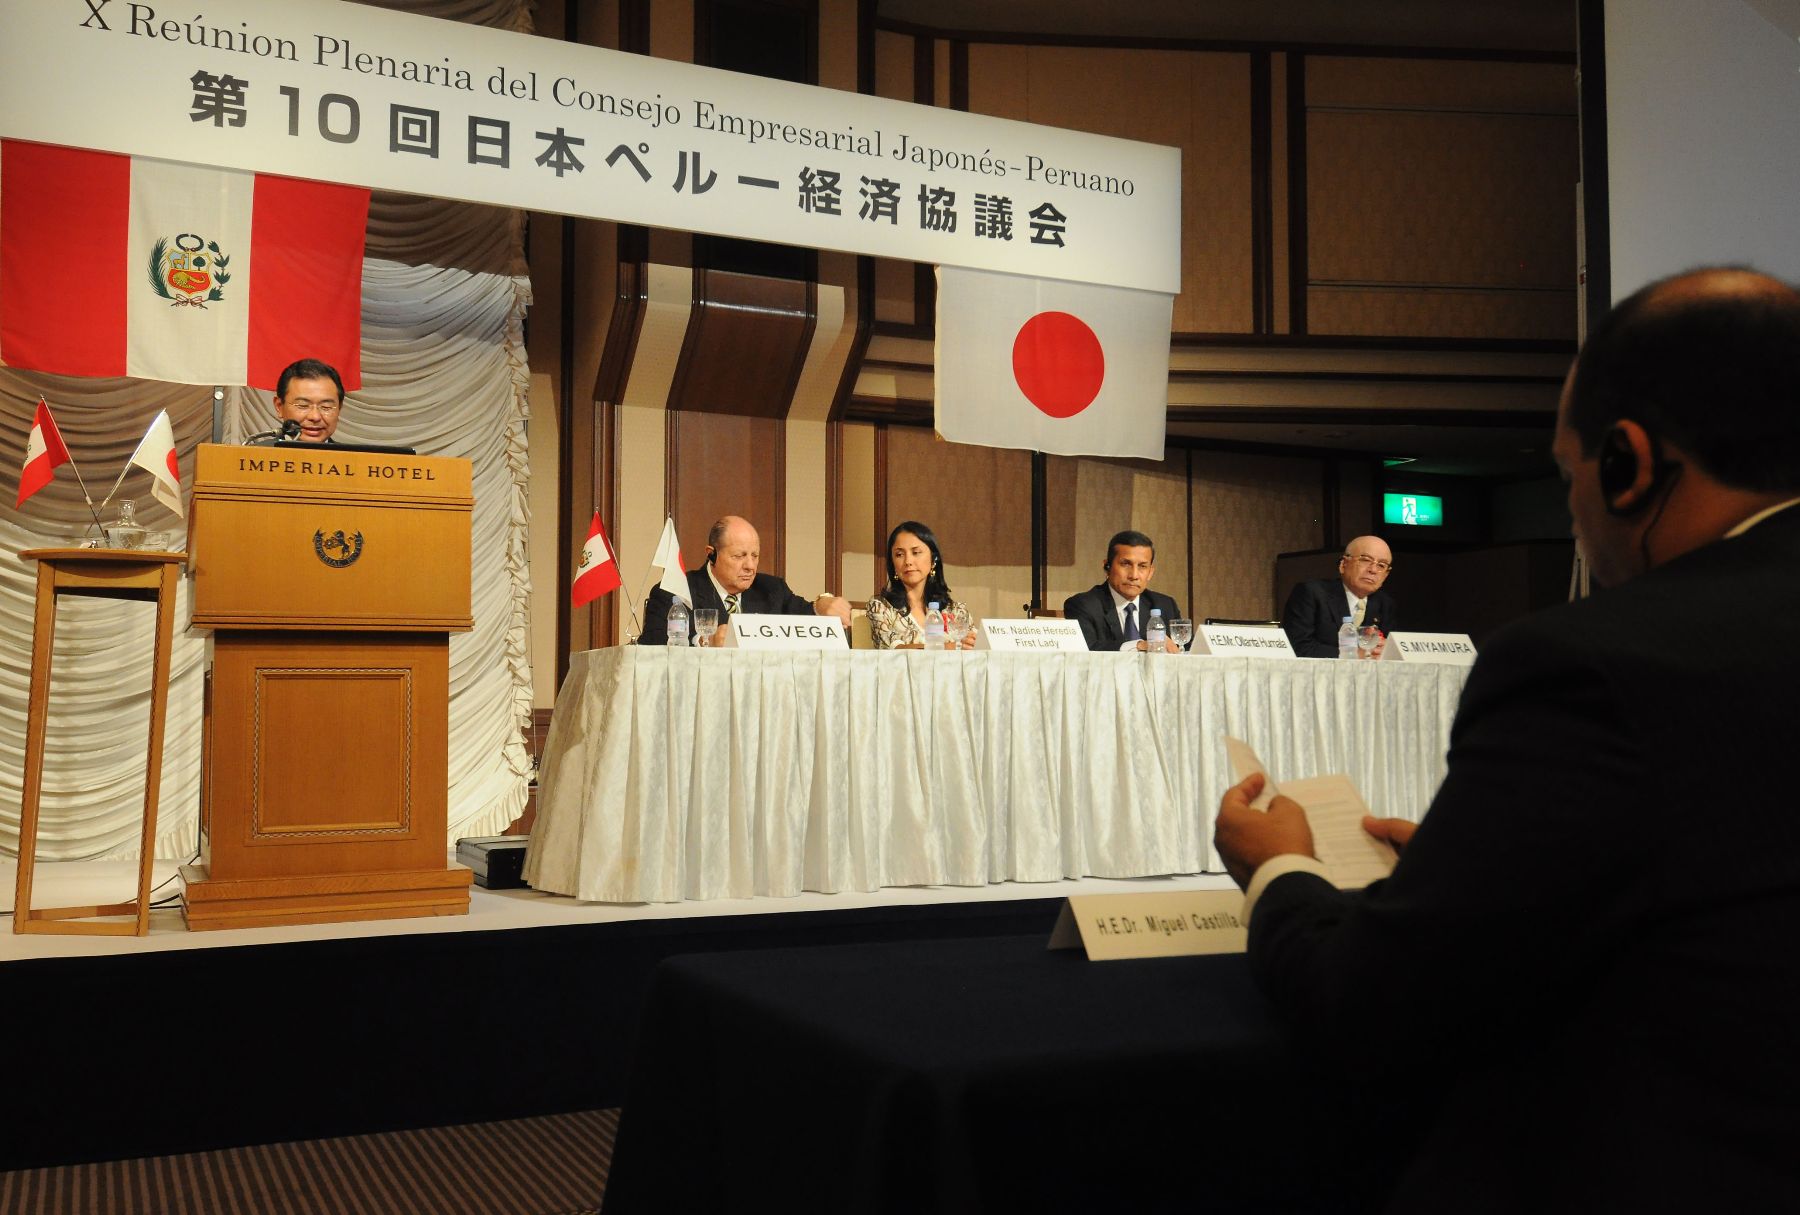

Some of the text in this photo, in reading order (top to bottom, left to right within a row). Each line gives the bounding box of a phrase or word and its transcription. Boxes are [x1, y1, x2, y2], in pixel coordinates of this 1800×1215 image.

[80, 0, 111, 31] X
[126, 2, 299, 62] Reúnion
[313, 34, 474, 91] Plenaria
[487, 66, 539, 102] del
[552, 77, 681, 128] Consejo
[693, 100, 883, 158] Empresarial
[239, 458, 436, 481] IMPERIAL HOTEL
[738, 624, 838, 639] L.G.VEGA
[988, 625, 1077, 636] Mrs. Nadine Heredia
[1015, 638, 1059, 649] First Lady
[1400, 641, 1472, 654] S.MIYAMURA
[1145, 914, 1189, 936] Miguel
[1191, 911, 1240, 930] Castilla
